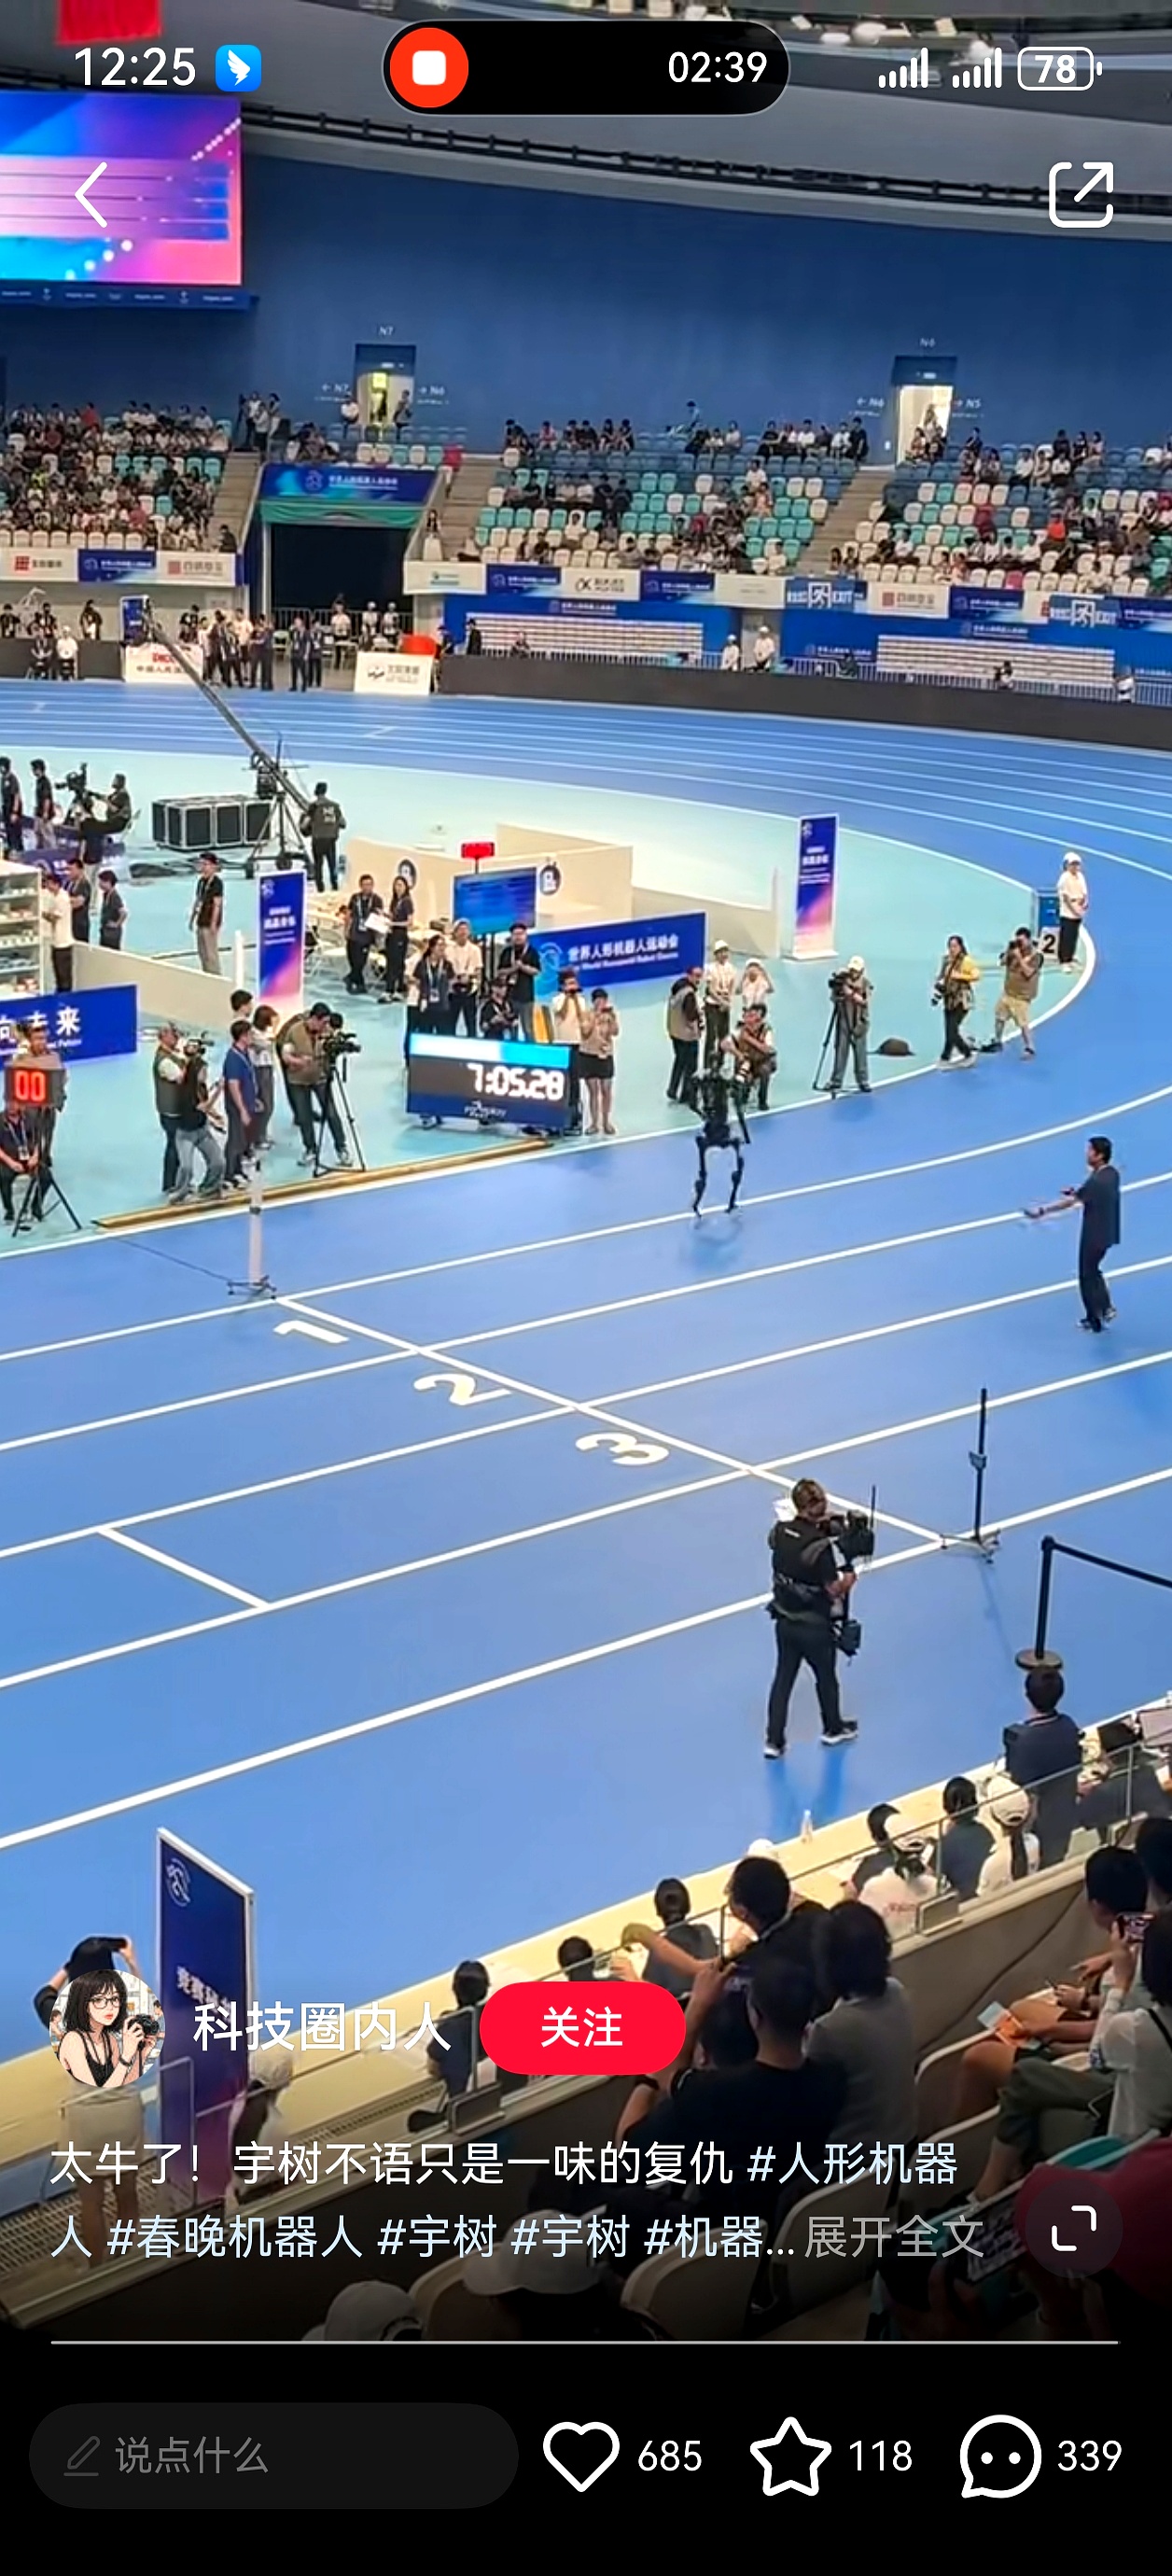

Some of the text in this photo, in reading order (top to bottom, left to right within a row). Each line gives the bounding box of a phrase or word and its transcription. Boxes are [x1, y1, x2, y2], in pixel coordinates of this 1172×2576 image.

[1041, 934, 1056, 954] 2
[15, 1070, 46, 1101] 00
[273, 1320, 349, 1344] 1
[413, 1373, 512, 1407] 2
[575, 1432, 670, 1466] 3
